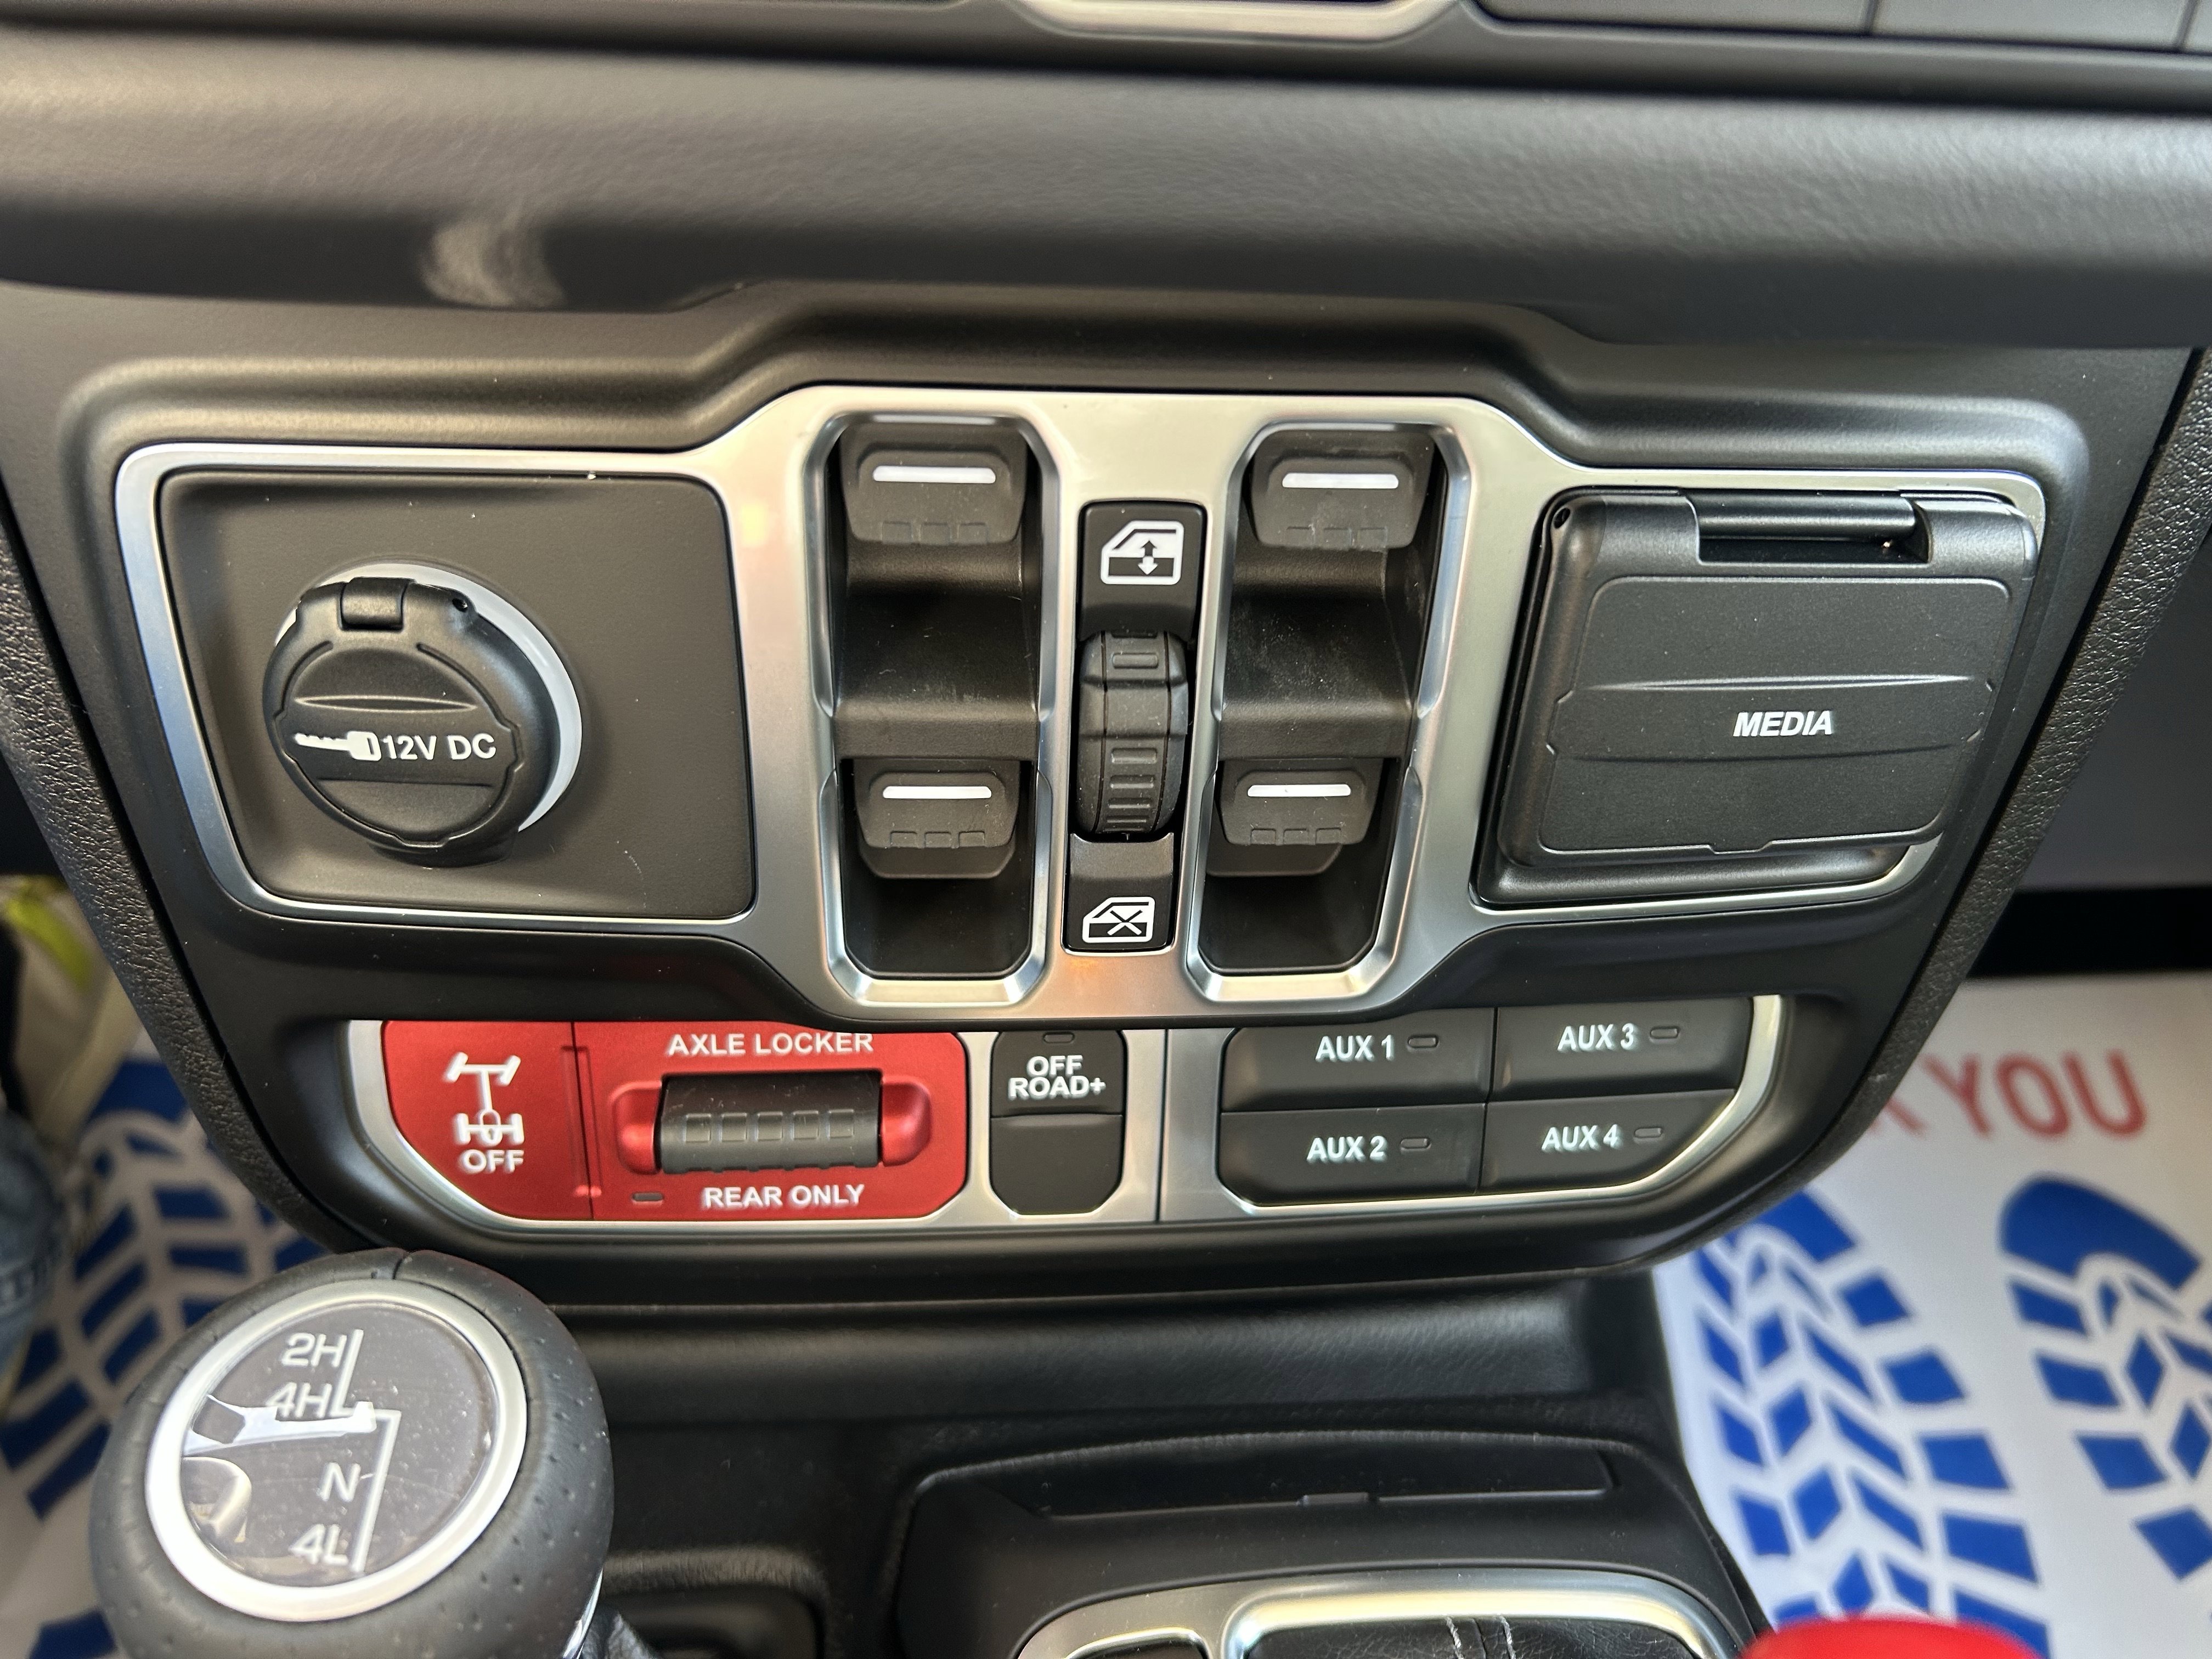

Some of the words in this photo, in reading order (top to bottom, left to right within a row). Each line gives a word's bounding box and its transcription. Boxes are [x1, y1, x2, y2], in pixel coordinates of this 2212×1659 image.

[1733, 710, 1833, 737] MEDIA
[383, 735, 437, 760] 12V
[449, 733, 496, 760] DC
[668, 1033, 746, 1056] AXLE
[753, 1032, 874, 1054] LOCKER
[1315, 1035, 1373, 1062] AUX
[1380, 1034, 1395, 1060] 1
[1557, 1024, 1615, 1052] AUX
[1620, 1023, 1636, 1050] 3
[1026, 1056, 1084, 1077] OFF
[1008, 1075, 1107, 1100] ROAD+
[1918, 1049, 2147, 1139] YOU
[1306, 1136, 1363, 1163] AUX
[1368, 1135, 1387, 1160] 2
[1541, 1126, 1599, 1153] AUX
[1602, 1124, 1621, 1149] 4
[461, 1149, 524, 1173] OFF
[703, 1186, 783, 1210] REAR
[787, 1184, 865, 1206] ONLY
[280, 1331, 348, 1369] 2H
[264, 1381, 332, 1418] 4H
[318, 1461, 360, 1503] N
[290, 1523, 350, 1566] 4L
